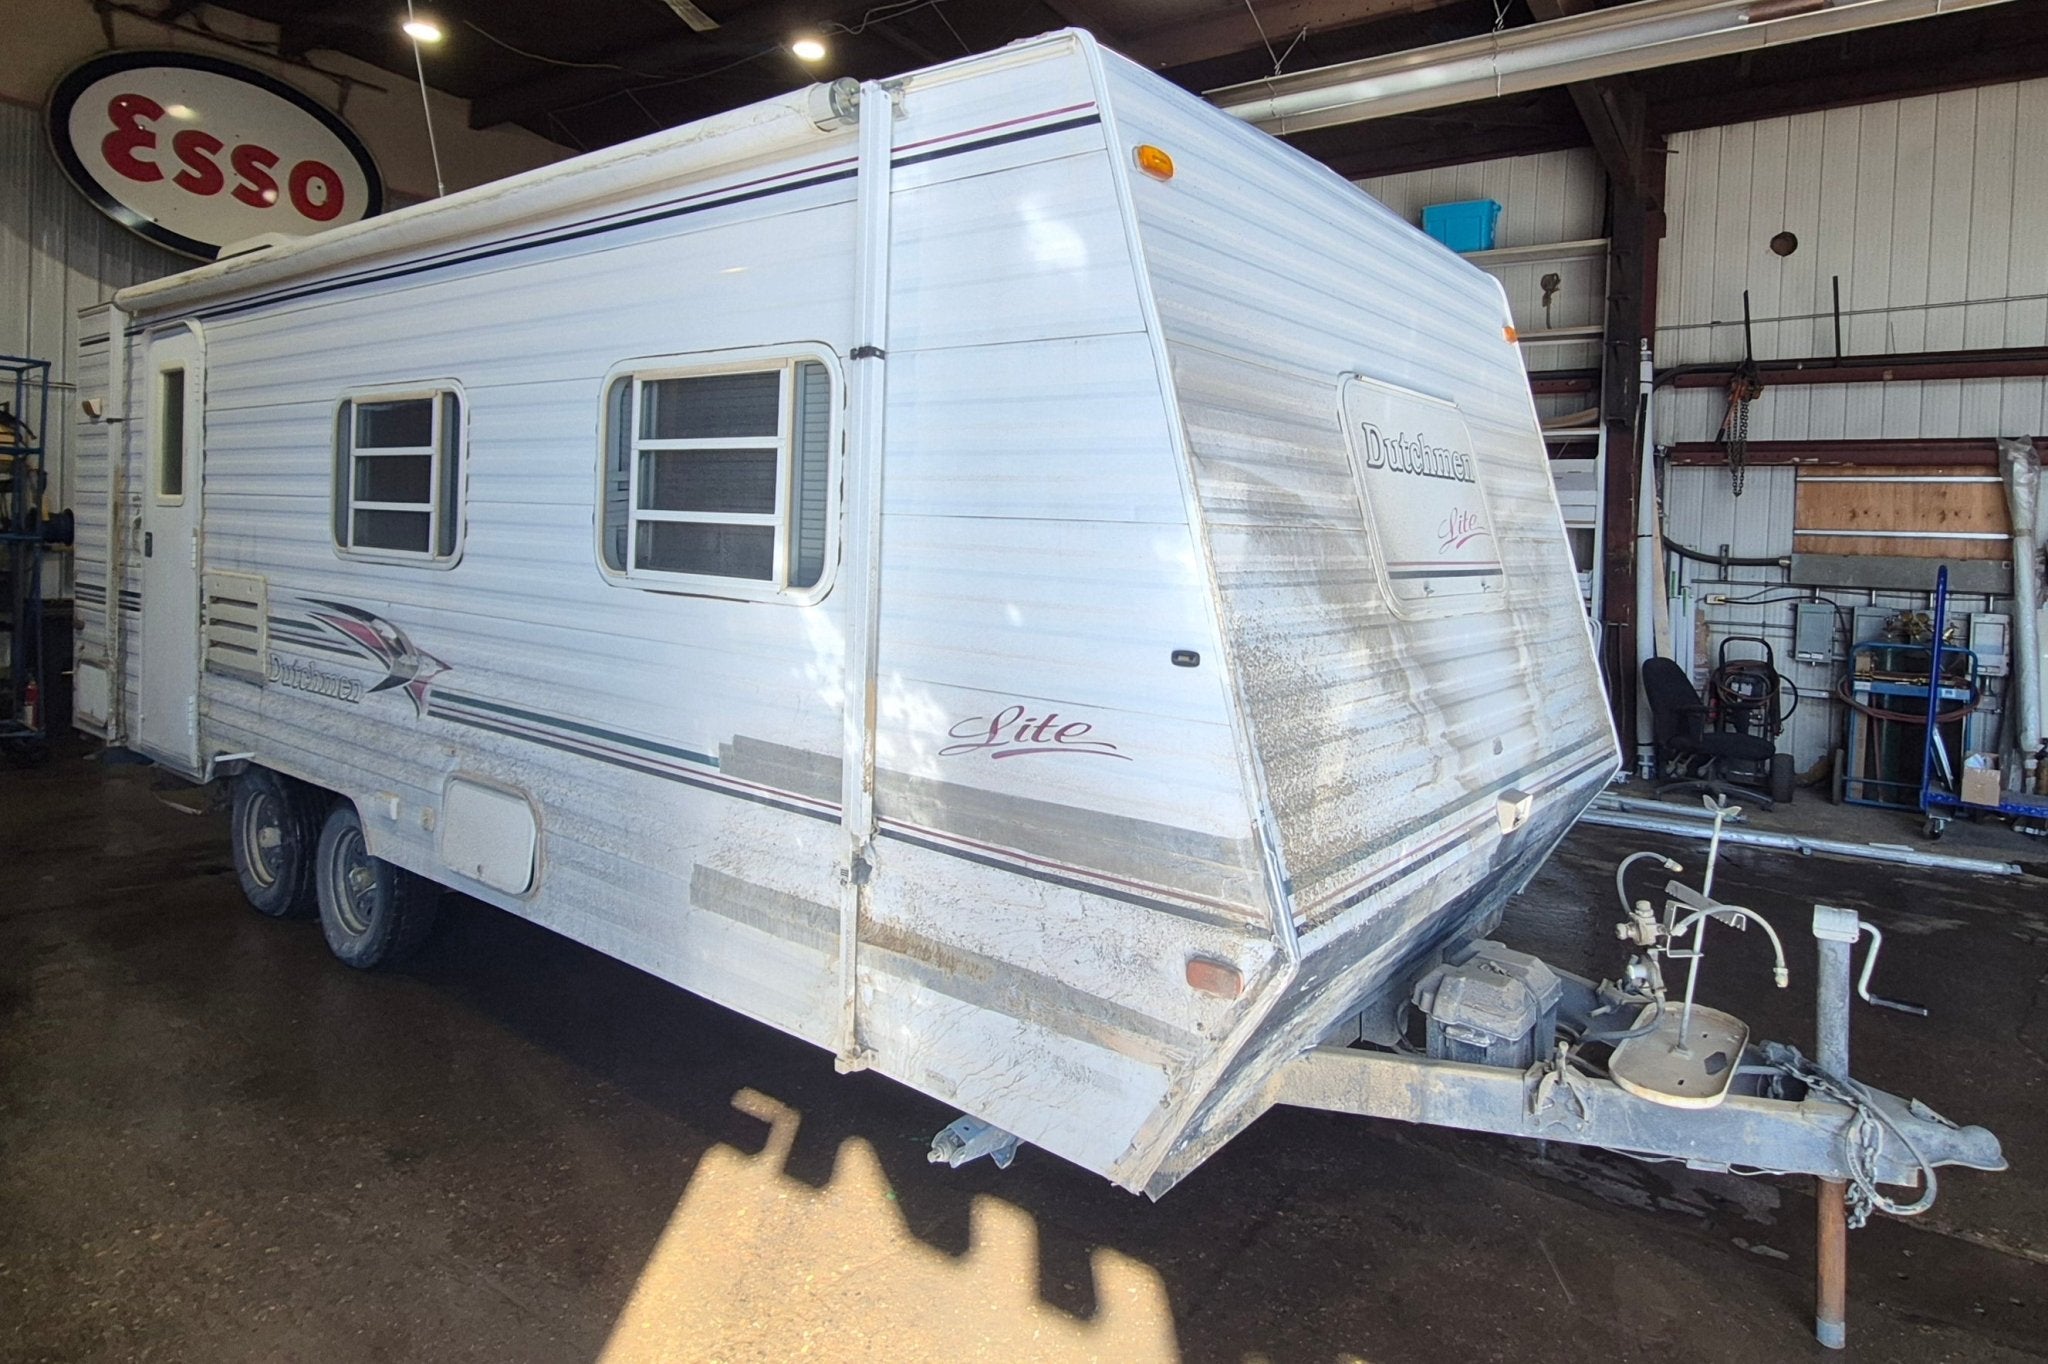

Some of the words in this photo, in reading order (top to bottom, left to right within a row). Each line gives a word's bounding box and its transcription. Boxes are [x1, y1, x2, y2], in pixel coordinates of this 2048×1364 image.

[1361, 422, 1475, 483] Dutchmen
[1438, 507, 1485, 555] Lite
[269, 652, 363, 704] Dutchmen
[939, 705, 1117, 757] Lite
